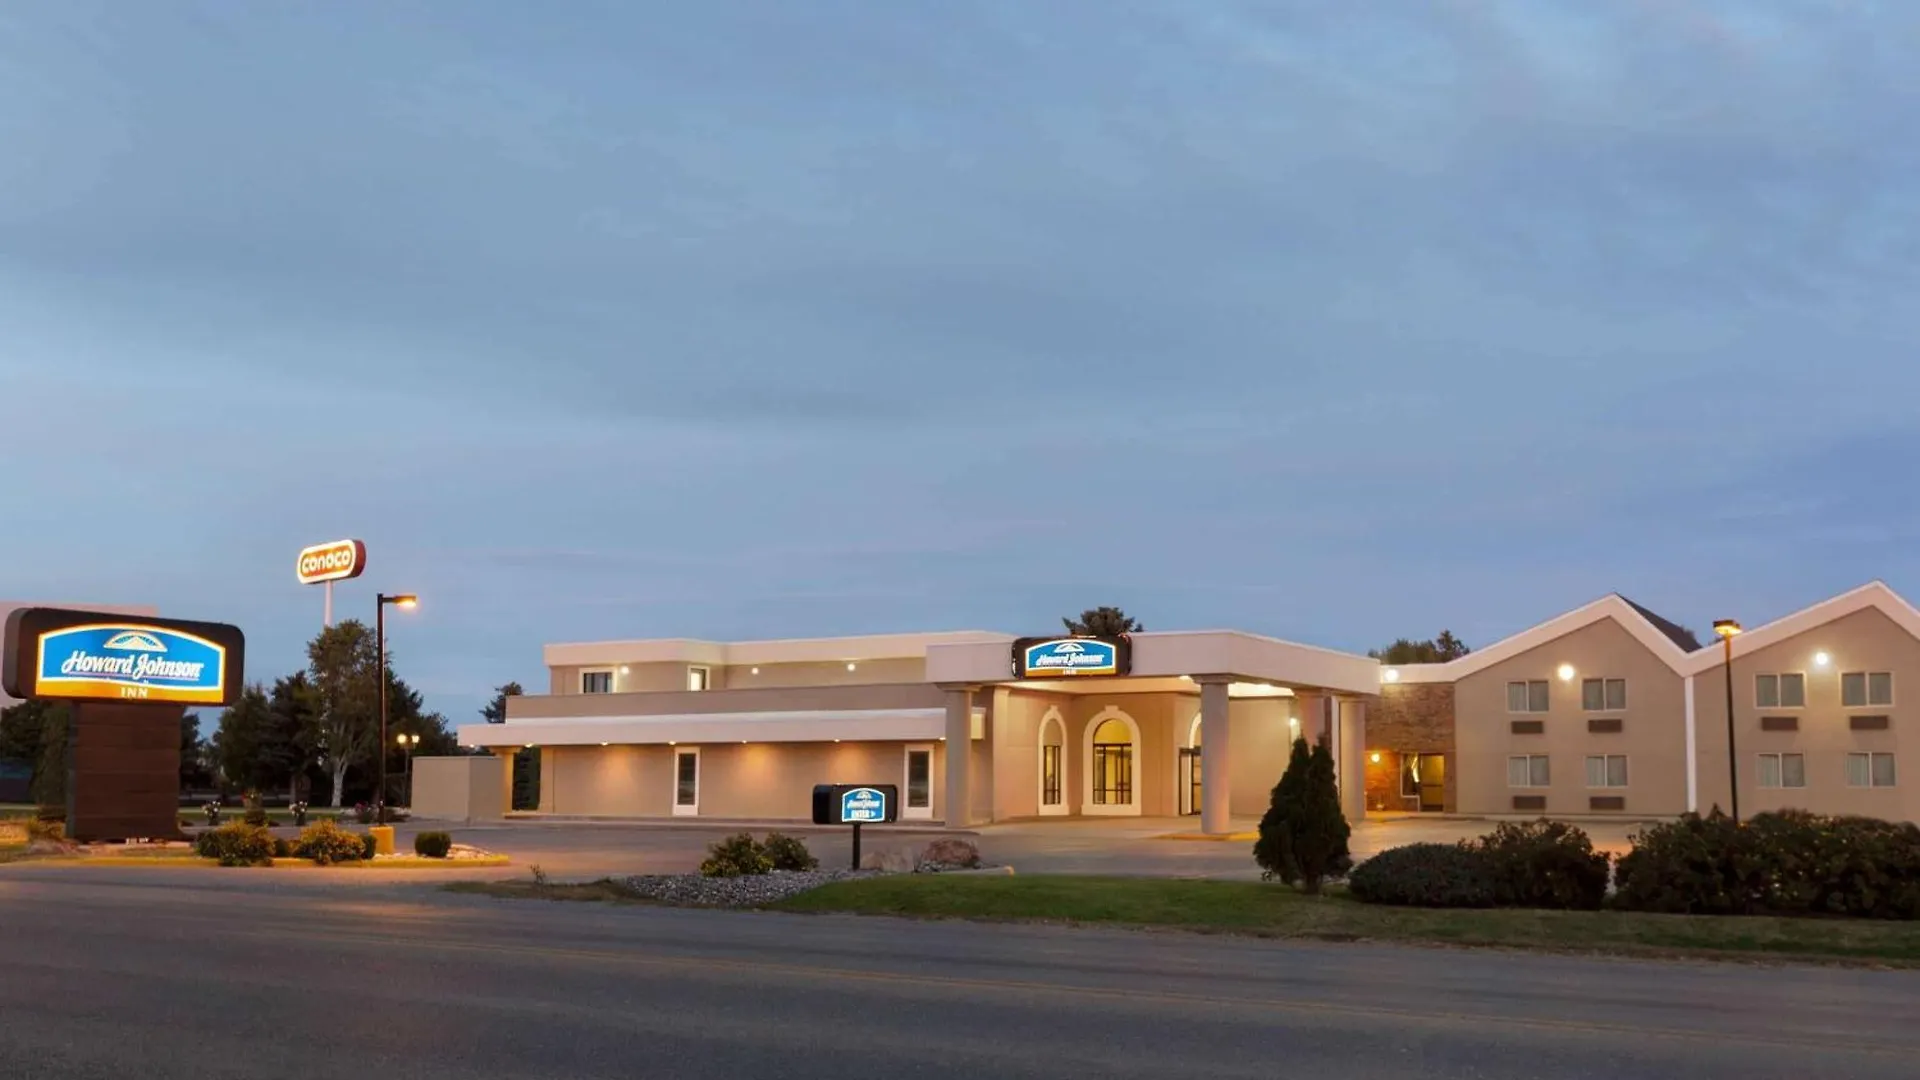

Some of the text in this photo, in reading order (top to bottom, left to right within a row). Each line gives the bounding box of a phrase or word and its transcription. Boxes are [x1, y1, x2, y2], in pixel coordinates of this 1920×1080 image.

[61, 650, 204, 680] Howard Johnson
[120, 687, 149, 698] INN
